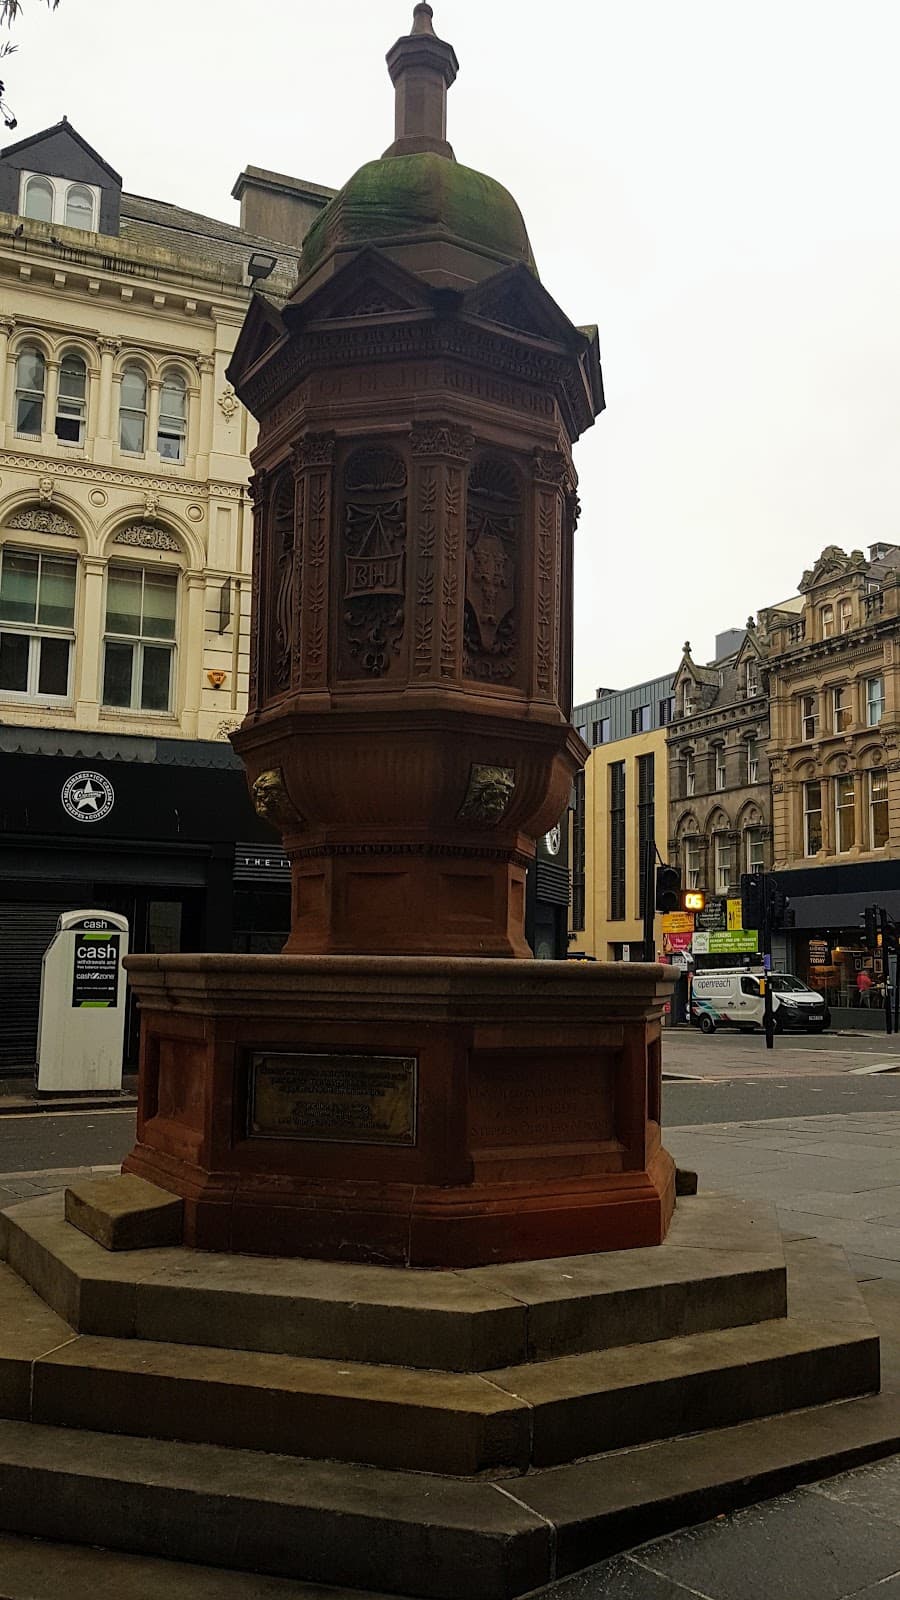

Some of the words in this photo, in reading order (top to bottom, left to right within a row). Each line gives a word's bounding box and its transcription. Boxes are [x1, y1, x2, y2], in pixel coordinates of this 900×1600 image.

[244, 858, 271, 866] THE
[83, 920, 107, 929] cash
[77, 944, 117, 959] cash
[697, 978, 731, 989] openreach
